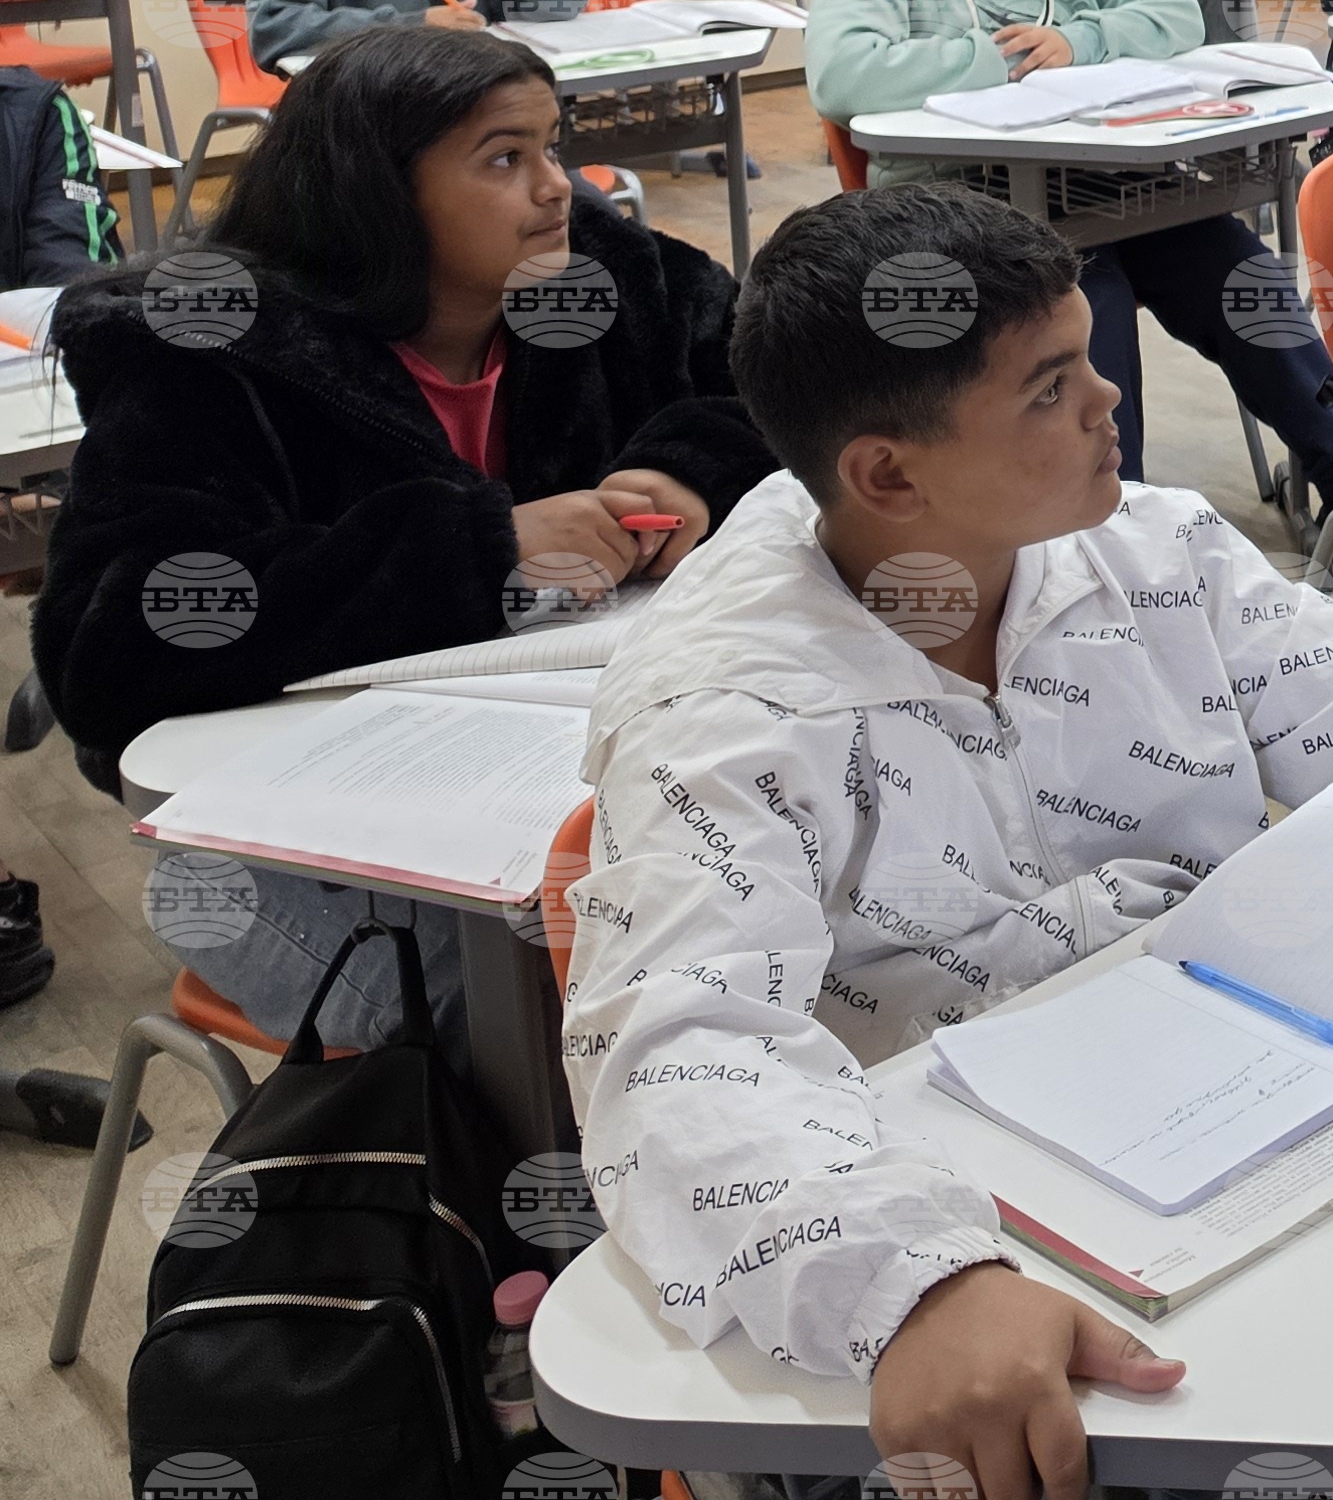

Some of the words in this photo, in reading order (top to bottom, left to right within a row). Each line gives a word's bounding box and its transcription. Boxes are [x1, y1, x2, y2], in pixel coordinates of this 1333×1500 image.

[1241, 603, 1301, 625] BALEN
[1004, 676, 1091, 707] ENCIAGA
[1128, 740, 1235, 779] BALENCIAGA
[650, 763, 737, 858] BALENCIAGA
[625, 1064, 760, 1093] BALENCIAGA
[693, 1179, 790, 1212] BALENCIA
